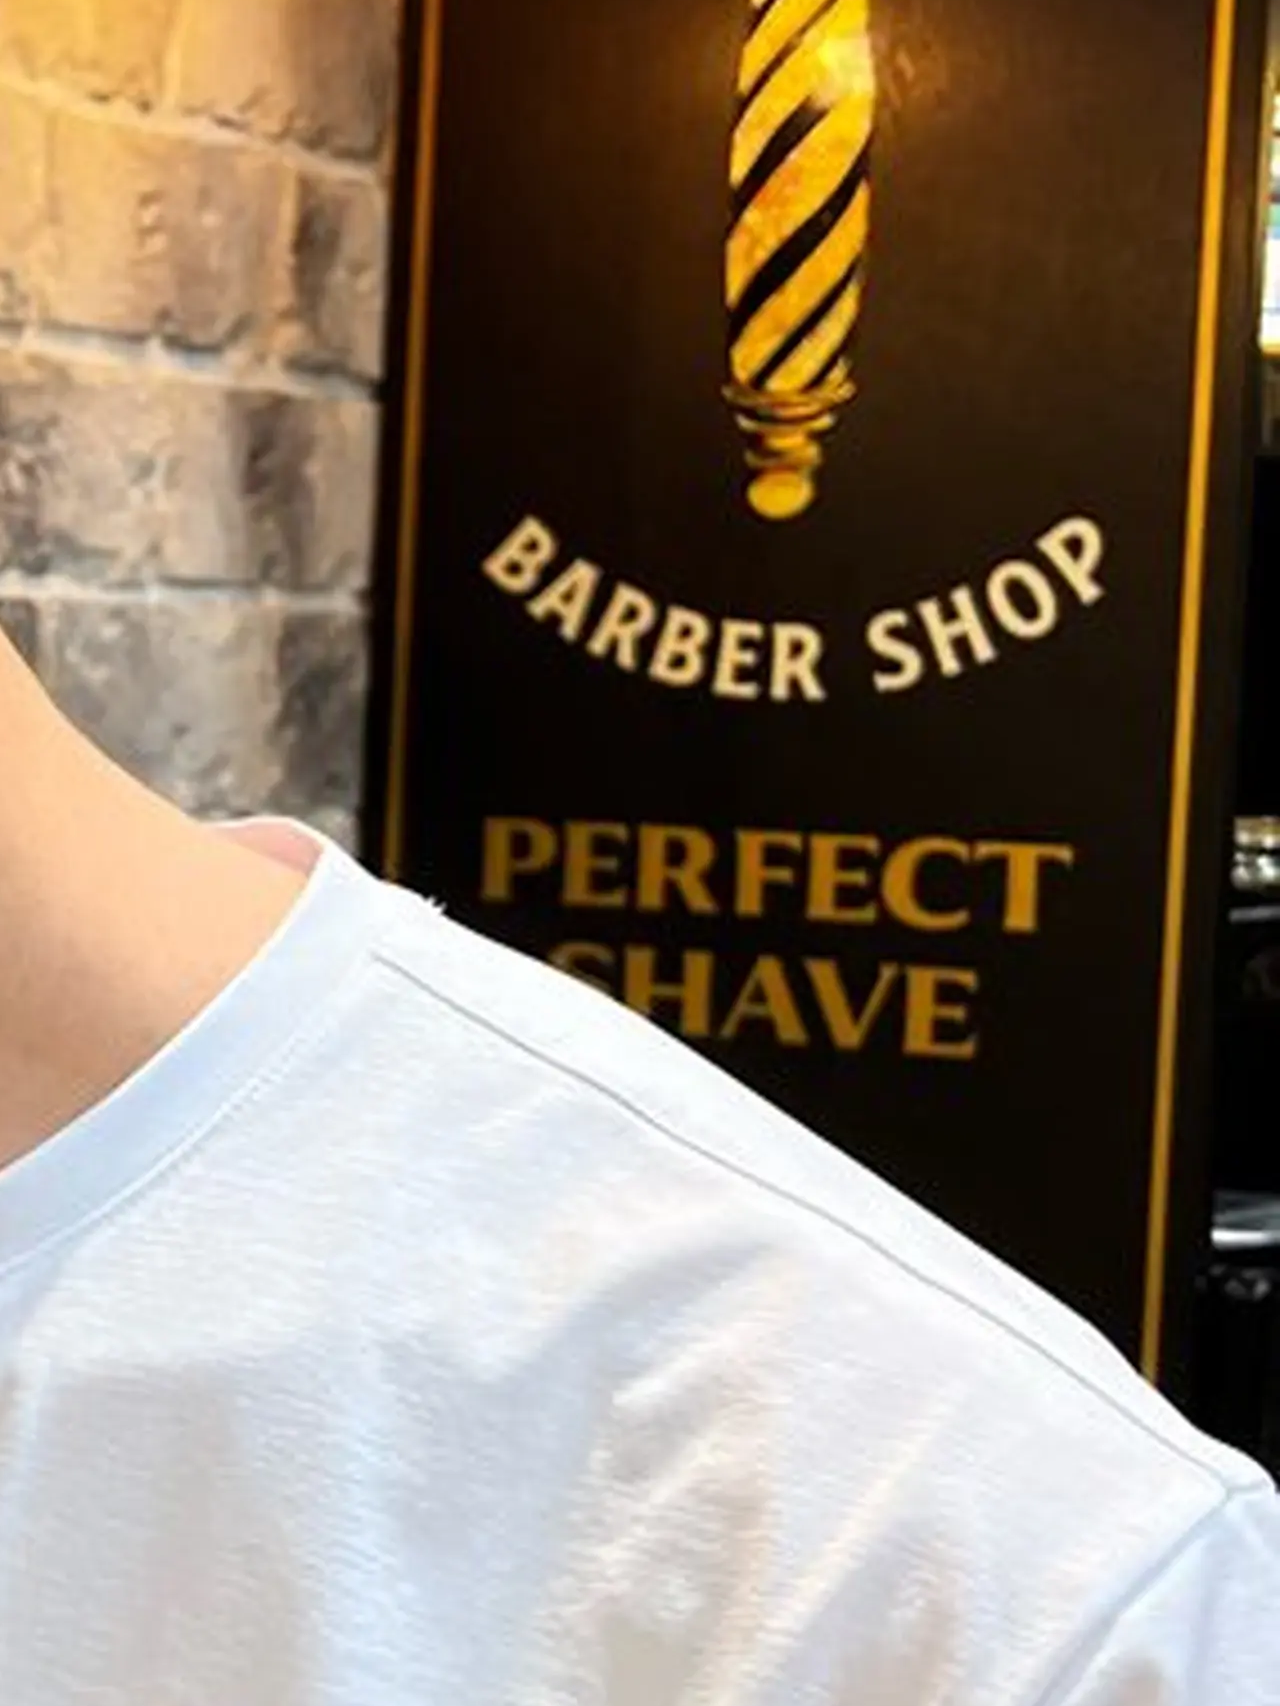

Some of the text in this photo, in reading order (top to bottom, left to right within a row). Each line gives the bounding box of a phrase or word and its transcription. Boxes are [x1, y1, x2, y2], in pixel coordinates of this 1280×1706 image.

[482, 516, 1104, 700] BARBER SHOP
[482, 817, 1073, 933] PERFECT
